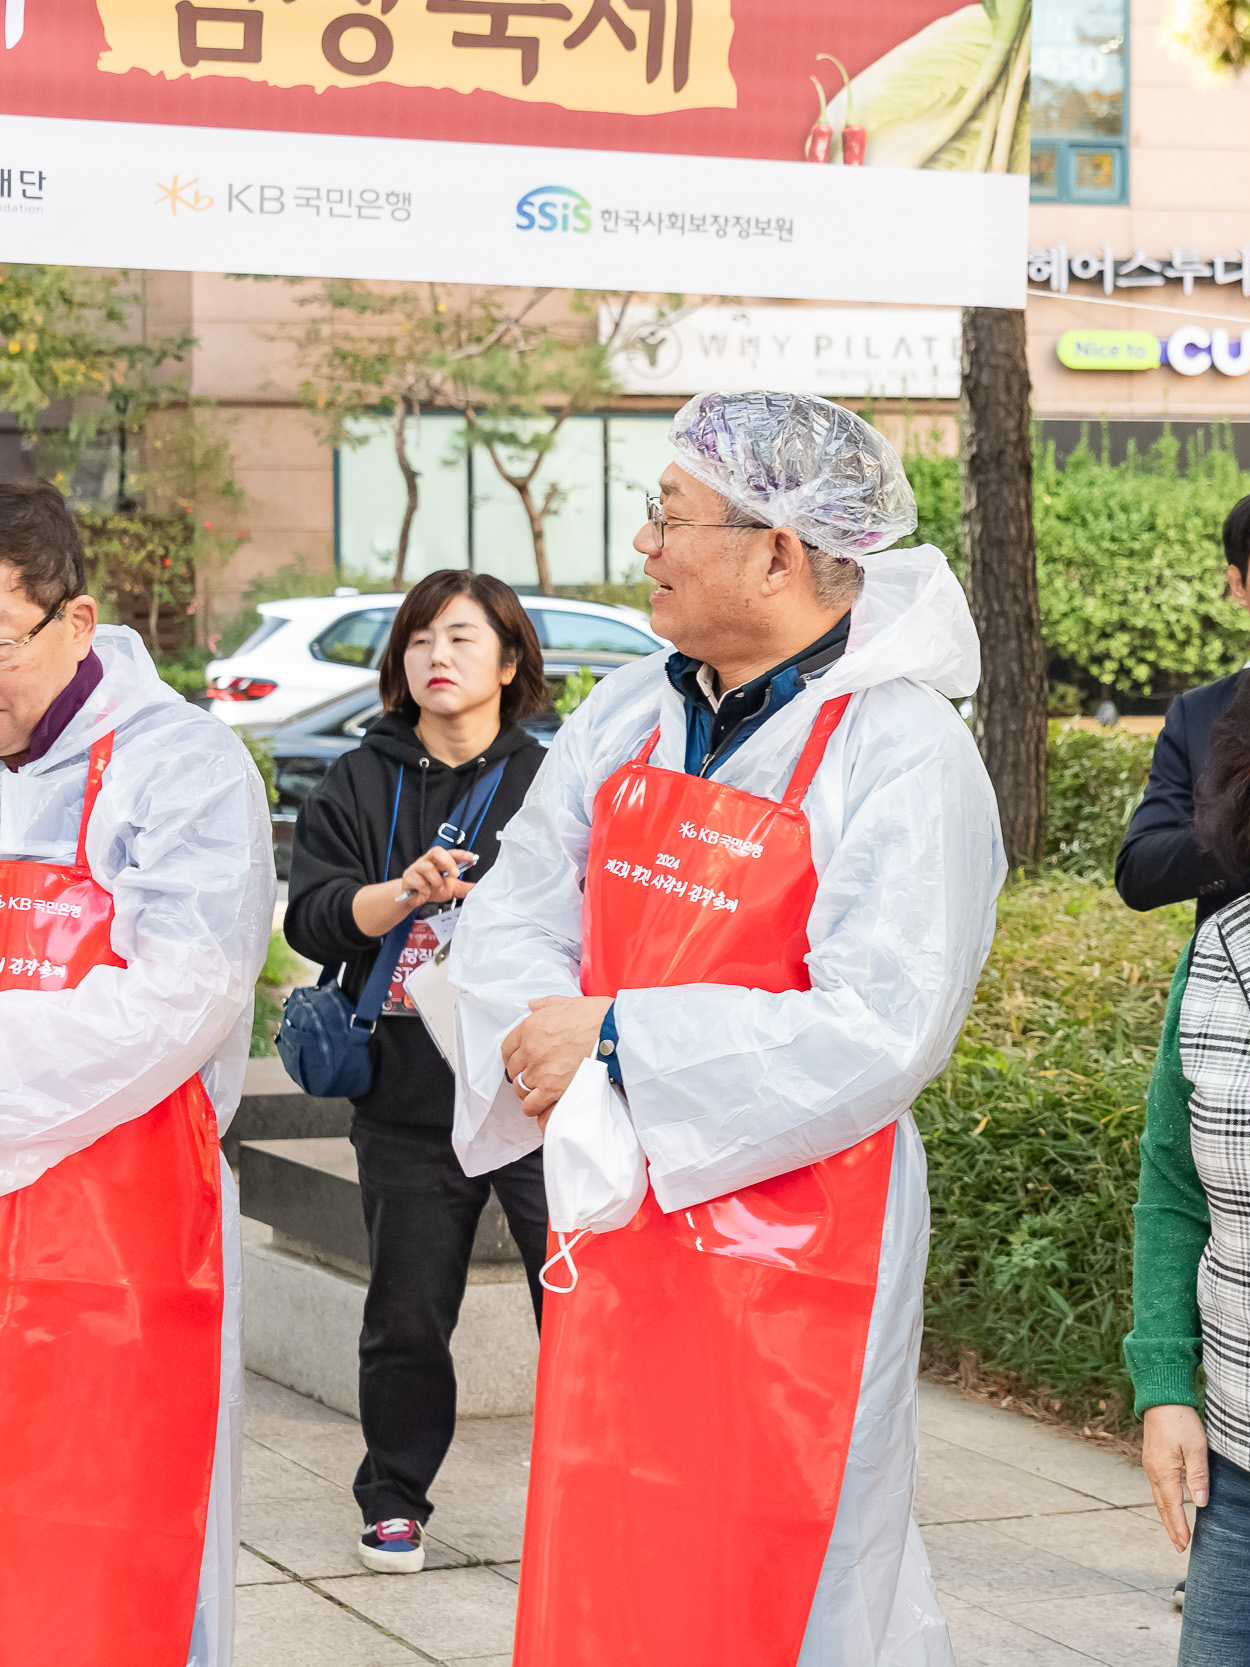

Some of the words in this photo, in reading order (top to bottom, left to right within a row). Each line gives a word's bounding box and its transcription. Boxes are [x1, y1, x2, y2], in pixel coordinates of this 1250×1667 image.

[600, 207, 793, 242] 한국사회보장정보원
[1074, 342, 1120, 359] Nice
[1126, 344, 1147, 359] to
[655, 852, 681, 870] 2024
[650, 873, 689, 898] 사랑의
[687, 883, 739, 913] 김장축제
[7, 957, 67, 979] 김장축제
